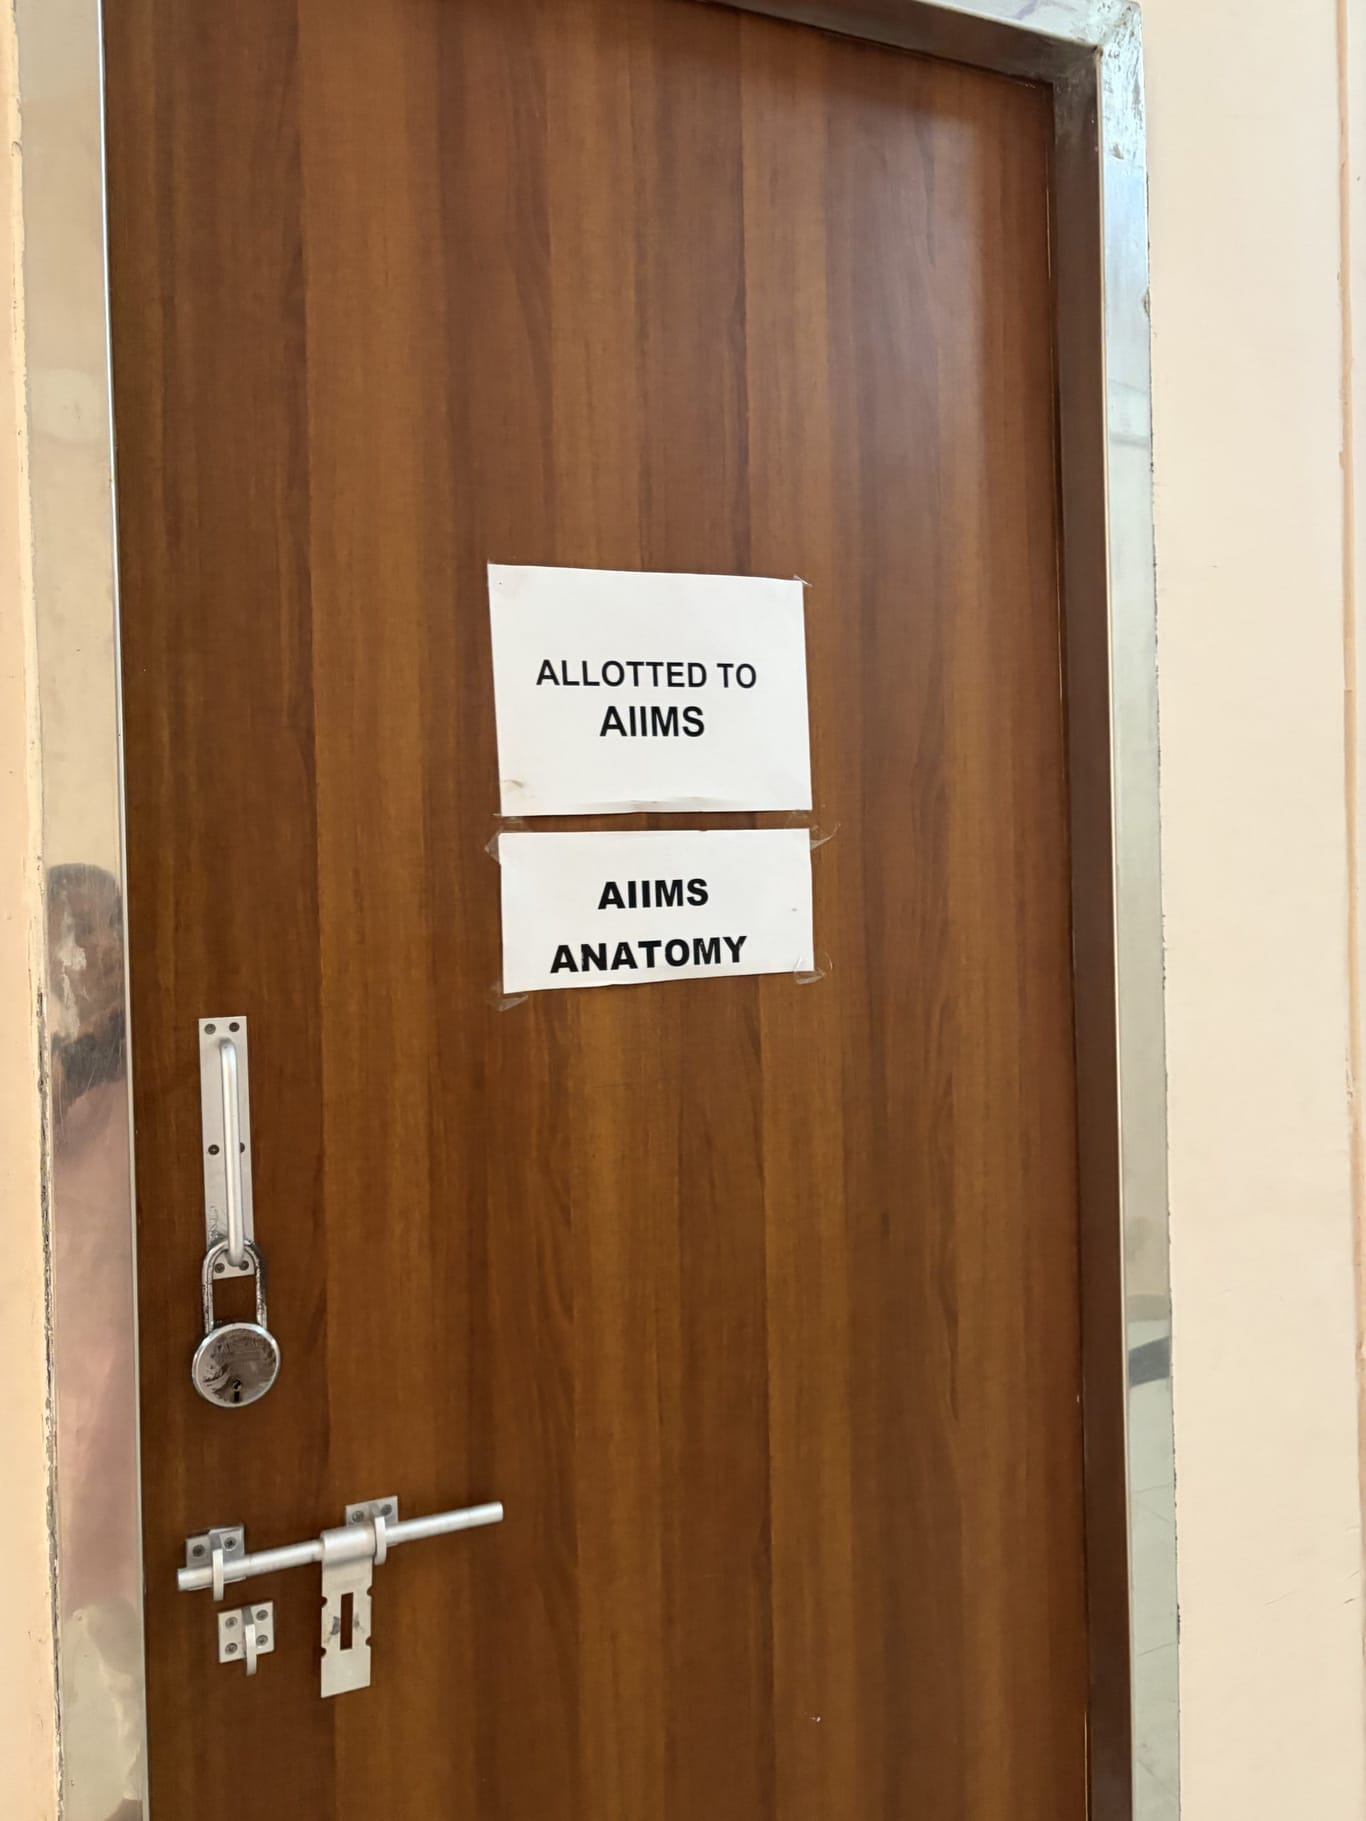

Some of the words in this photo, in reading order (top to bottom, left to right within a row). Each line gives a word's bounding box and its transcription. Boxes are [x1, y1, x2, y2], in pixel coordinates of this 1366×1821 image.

[536, 659, 707, 688] ALLOTTED
[716, 663, 757, 689] TO
[599, 705, 705, 738] AIIMS
[597, 878, 709, 910] AIIMS
[550, 935, 747, 974] ANATOMY
